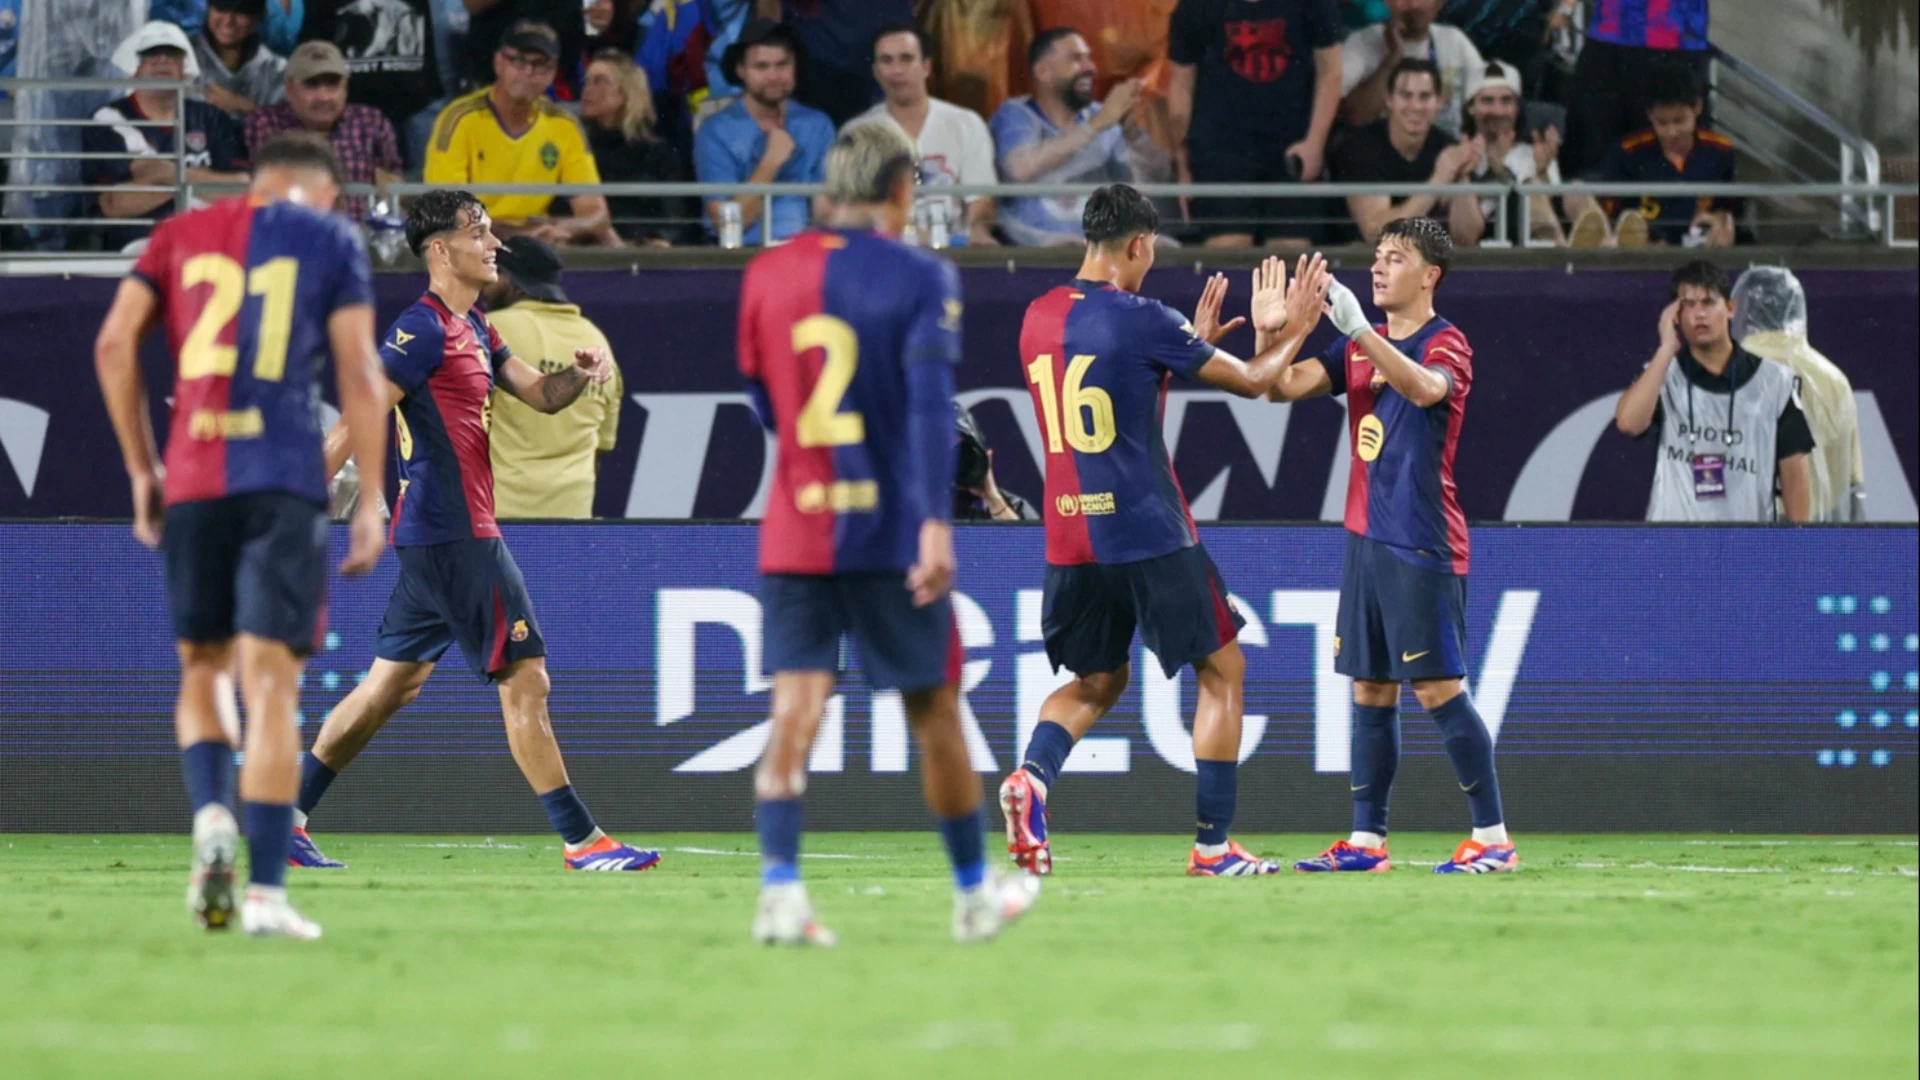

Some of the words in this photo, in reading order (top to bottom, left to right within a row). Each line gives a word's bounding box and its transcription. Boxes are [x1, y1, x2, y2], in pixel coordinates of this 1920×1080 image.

[179, 253, 299, 382] 21
[792, 315, 865, 448] 2
[1028, 354, 1117, 453] 16
[1667, 445, 1757, 474] MAHAL
[1678, 423, 1743, 445] PHOTO
